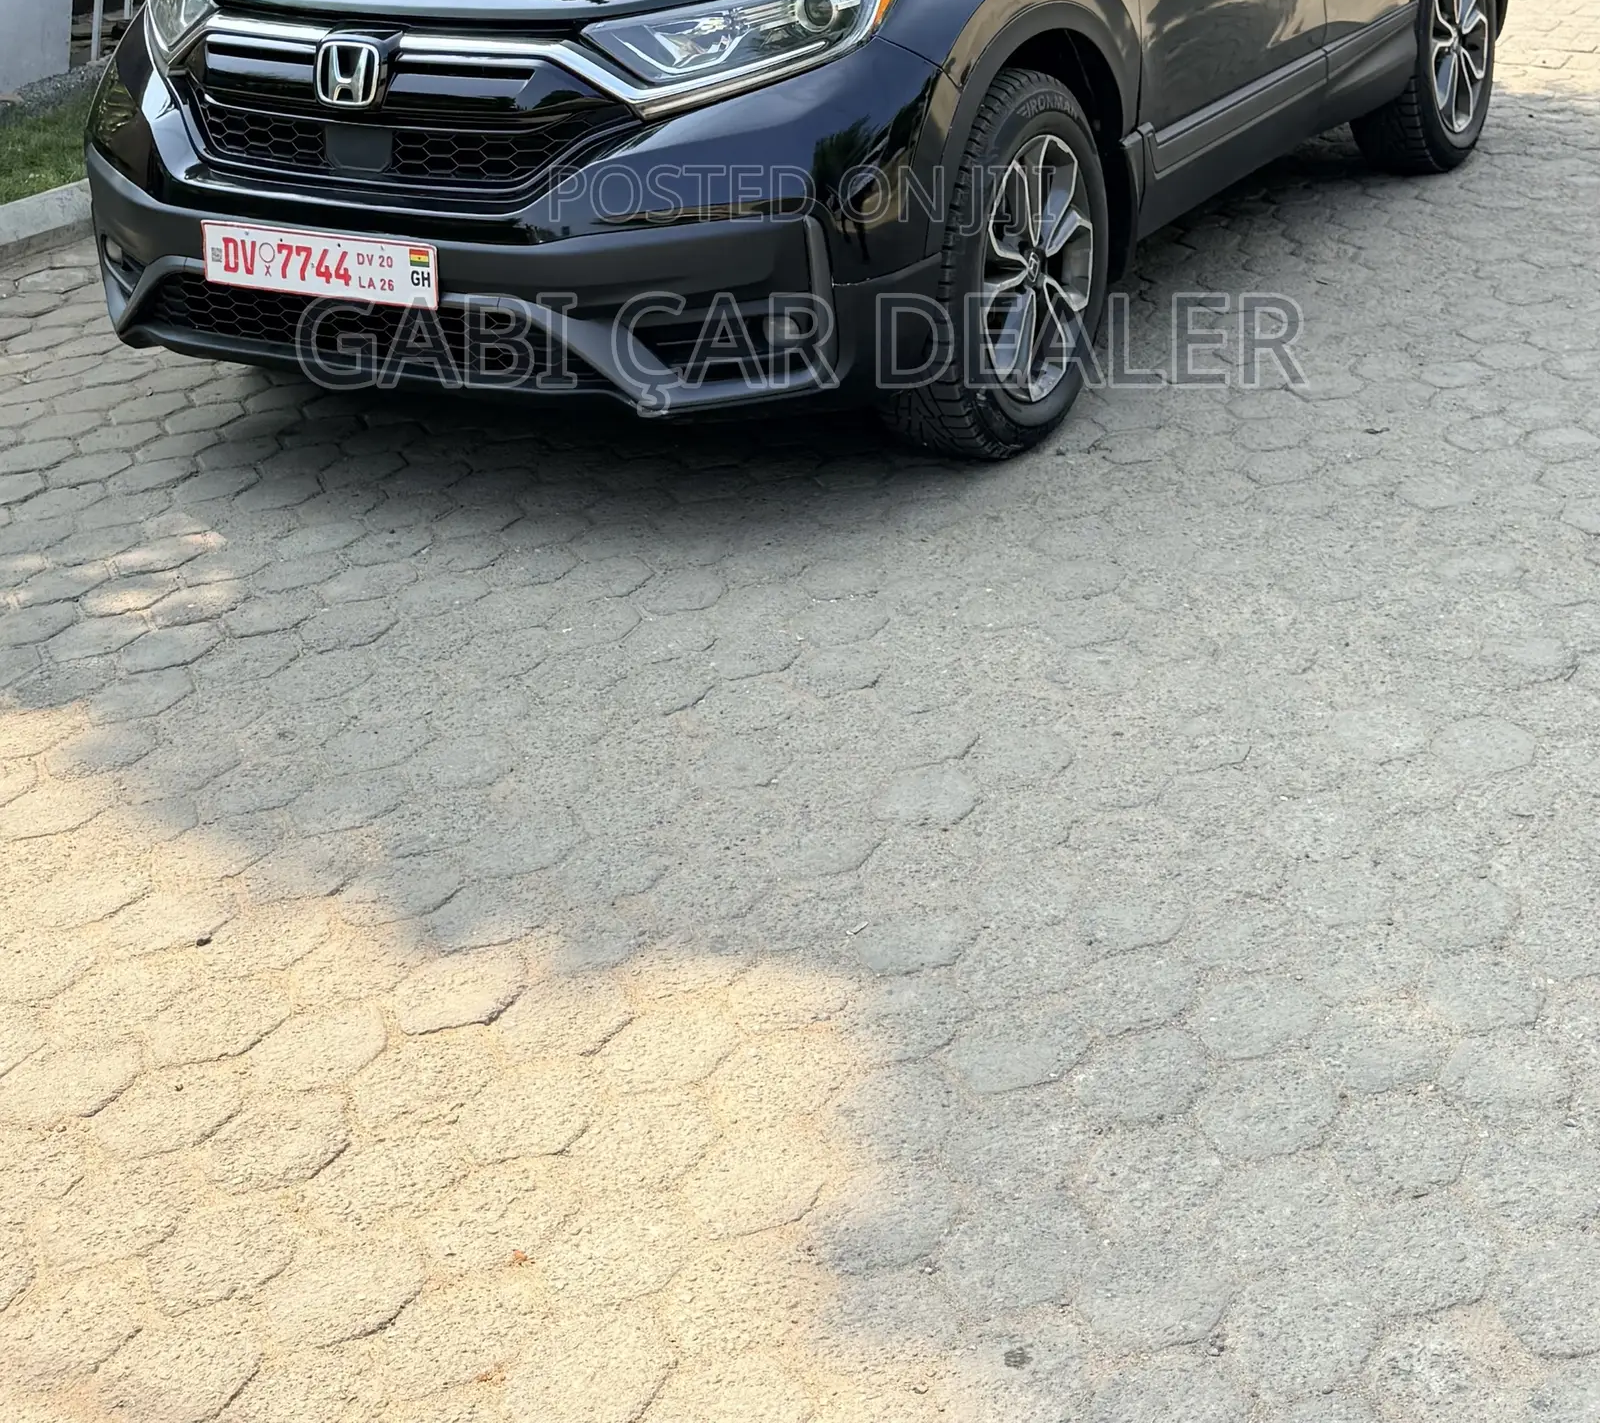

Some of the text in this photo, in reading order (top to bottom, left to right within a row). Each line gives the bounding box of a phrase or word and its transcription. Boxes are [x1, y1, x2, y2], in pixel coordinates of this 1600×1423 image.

[222, 237, 352, 287] DV 7744
[356, 252, 394, 269] DV 20
[358, 276, 395, 292] LA 26
[411, 270, 431, 288] GH
